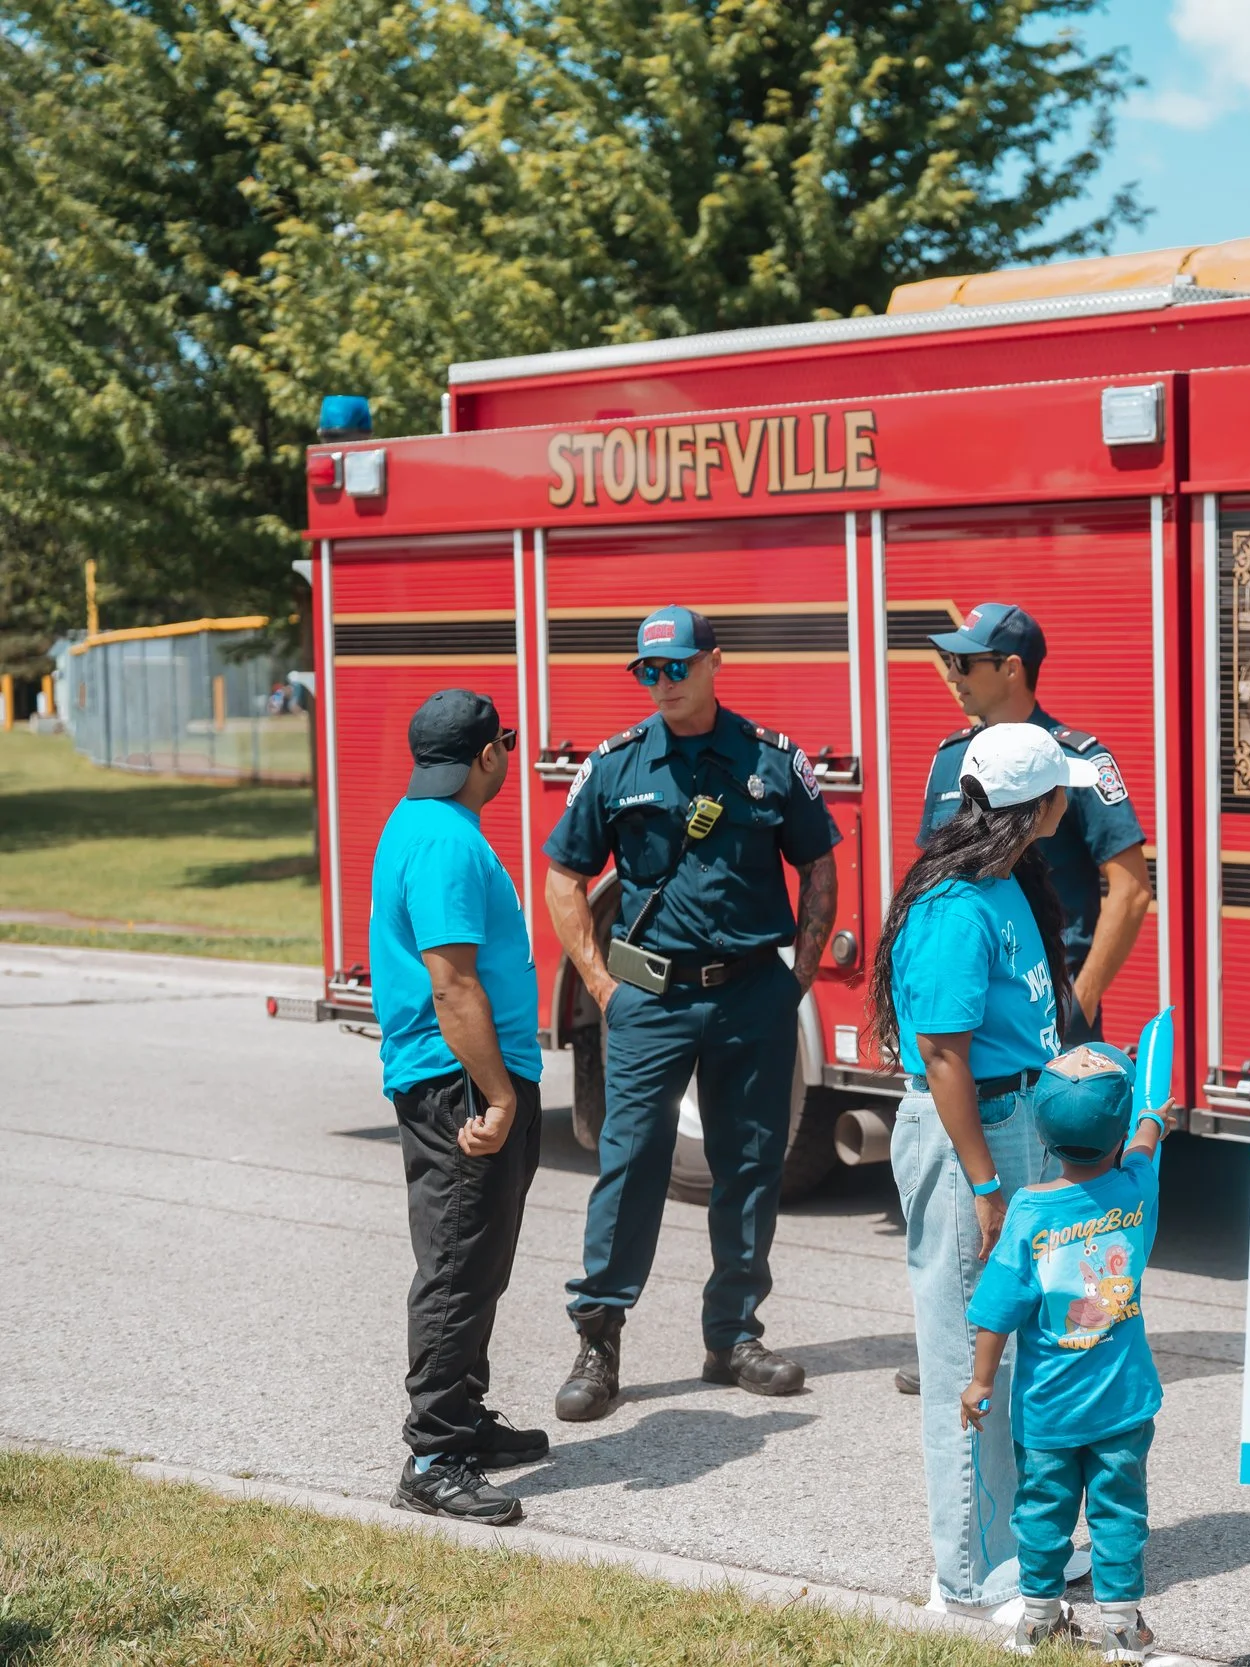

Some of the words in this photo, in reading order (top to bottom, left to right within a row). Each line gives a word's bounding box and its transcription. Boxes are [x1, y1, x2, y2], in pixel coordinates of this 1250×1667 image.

[547, 409, 882, 508] STOUFFVILLE
[1022, 958, 1053, 1002] WA
[1032, 1200, 1144, 1264] SpongeBob
